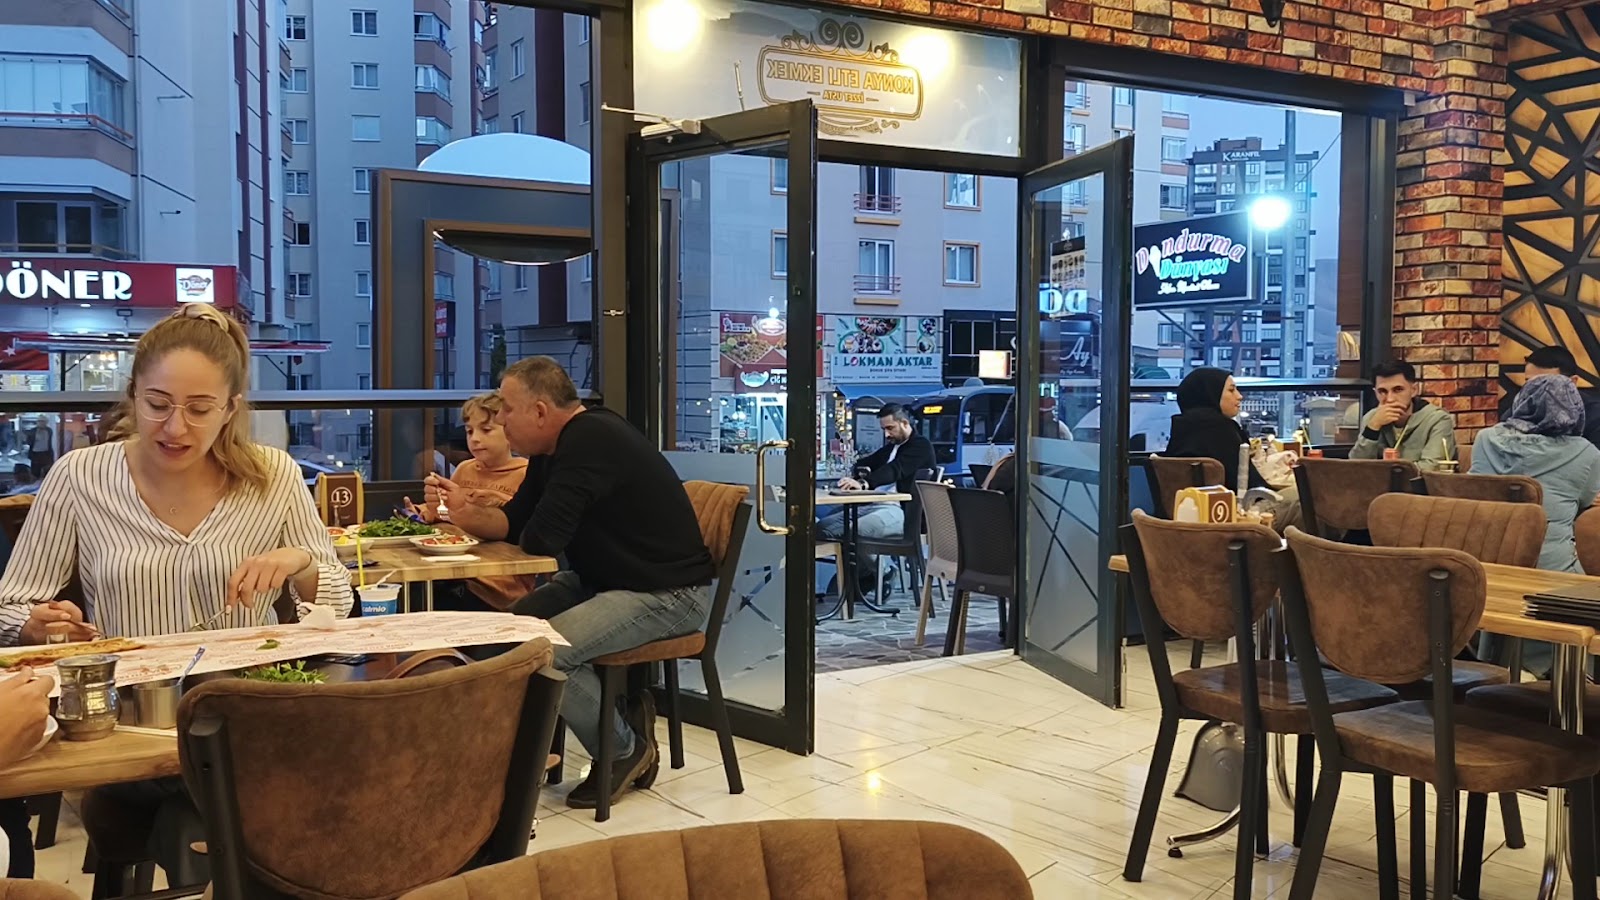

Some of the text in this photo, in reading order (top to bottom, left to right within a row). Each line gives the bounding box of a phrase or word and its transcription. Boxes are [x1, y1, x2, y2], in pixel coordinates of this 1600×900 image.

[1160, 256, 1230, 282] Dünyası
[0, 261, 132, 300] ÖNER
[843, 356, 933, 367] LOKMAN AKTAR
[334, 490, 349, 503] 13
[1217, 504, 1224, 520] 9
